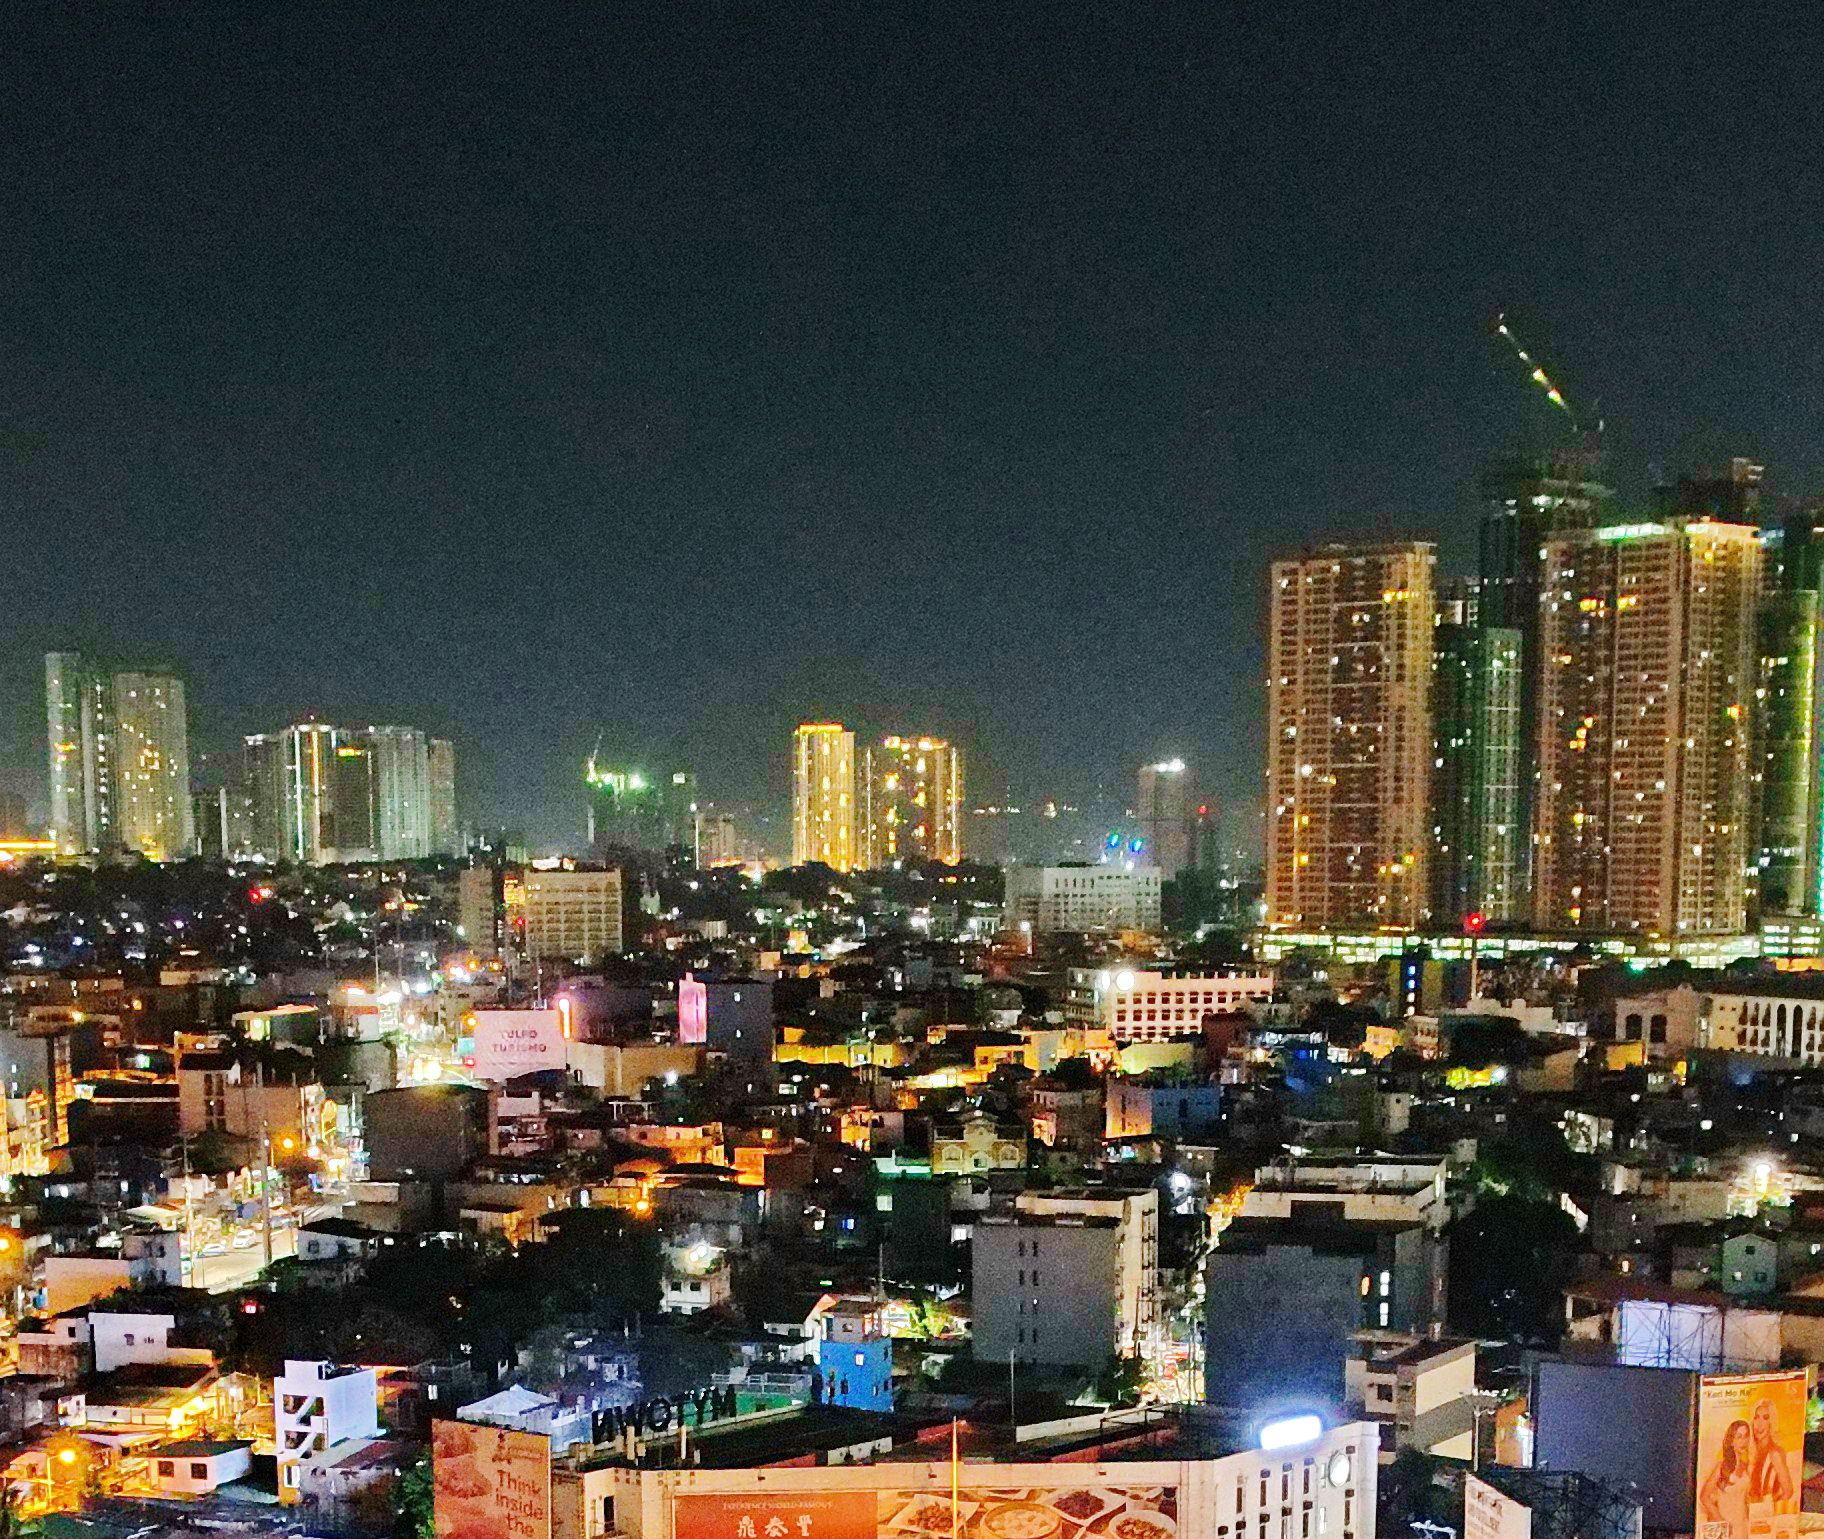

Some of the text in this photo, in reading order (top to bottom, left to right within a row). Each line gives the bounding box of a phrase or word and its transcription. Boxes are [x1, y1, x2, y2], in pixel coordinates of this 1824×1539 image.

[496, 1469, 542, 1496] Think
[495, 1487, 544, 1520] inside
[505, 1512, 534, 1537] the
